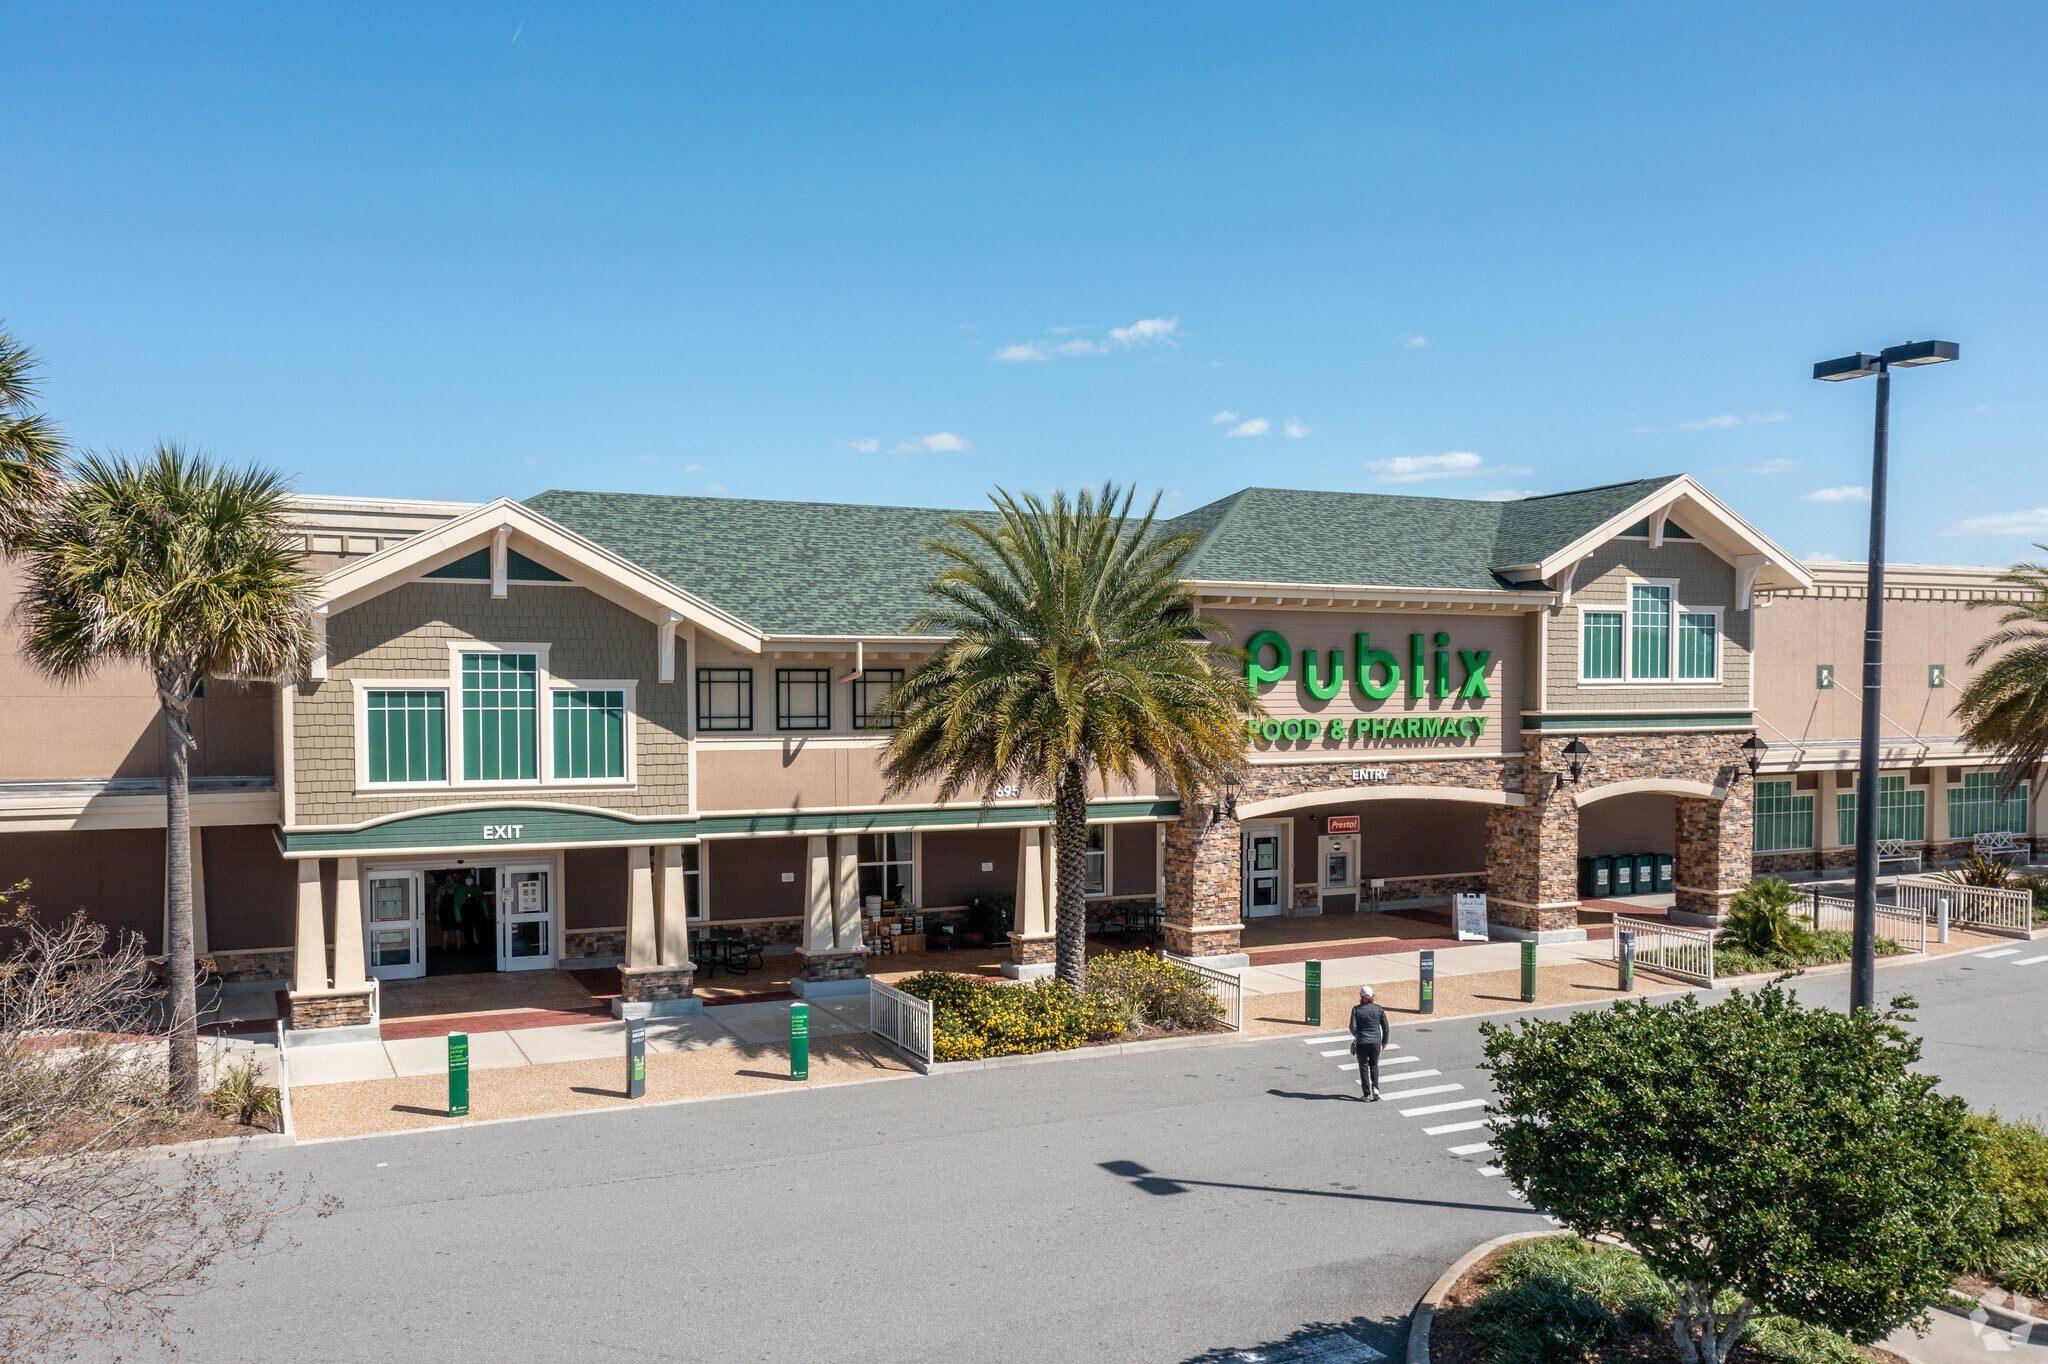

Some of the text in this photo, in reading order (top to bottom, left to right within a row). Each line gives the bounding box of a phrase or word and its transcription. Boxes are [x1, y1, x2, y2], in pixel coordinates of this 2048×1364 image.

[1244, 630, 1492, 701] Publix
[1247, 716, 1489, 742] FOOD & PHARMACY
[1352, 768, 1390, 781] ENTRY
[995, 784, 1020, 798] 695
[483, 824, 524, 840] EXIT
[1331, 820, 1357, 829] Presto!
